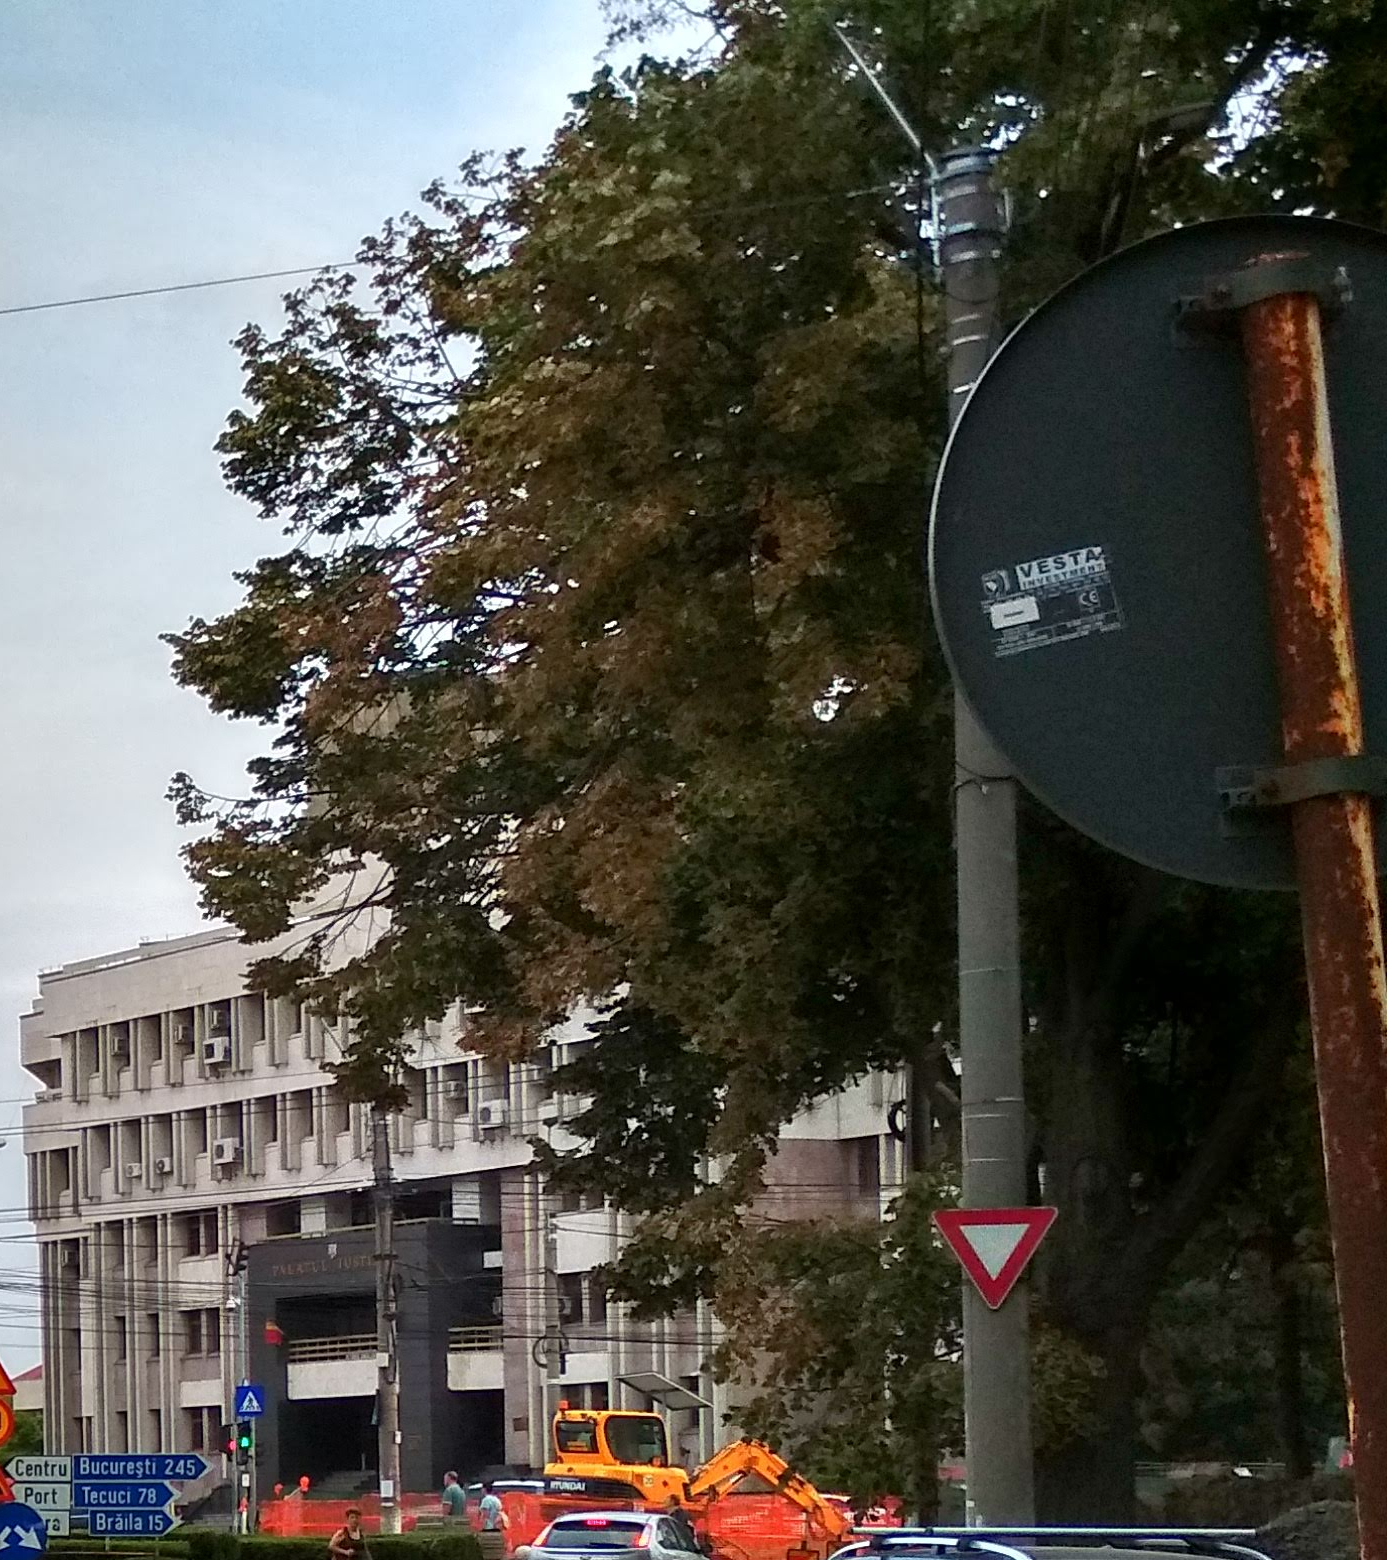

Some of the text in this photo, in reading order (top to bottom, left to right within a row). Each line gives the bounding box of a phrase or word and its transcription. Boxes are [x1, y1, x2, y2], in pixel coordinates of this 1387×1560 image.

[1019, 548, 1102, 578] VESTA
[15, 1459, 67, 1477] Centru
[164, 1459, 196, 1476] 245
[25, 1487, 57, 1504] Port
[82, 1486, 157, 1504] Tecuci 78
[96, 1513, 164, 1531] Brăila 15
